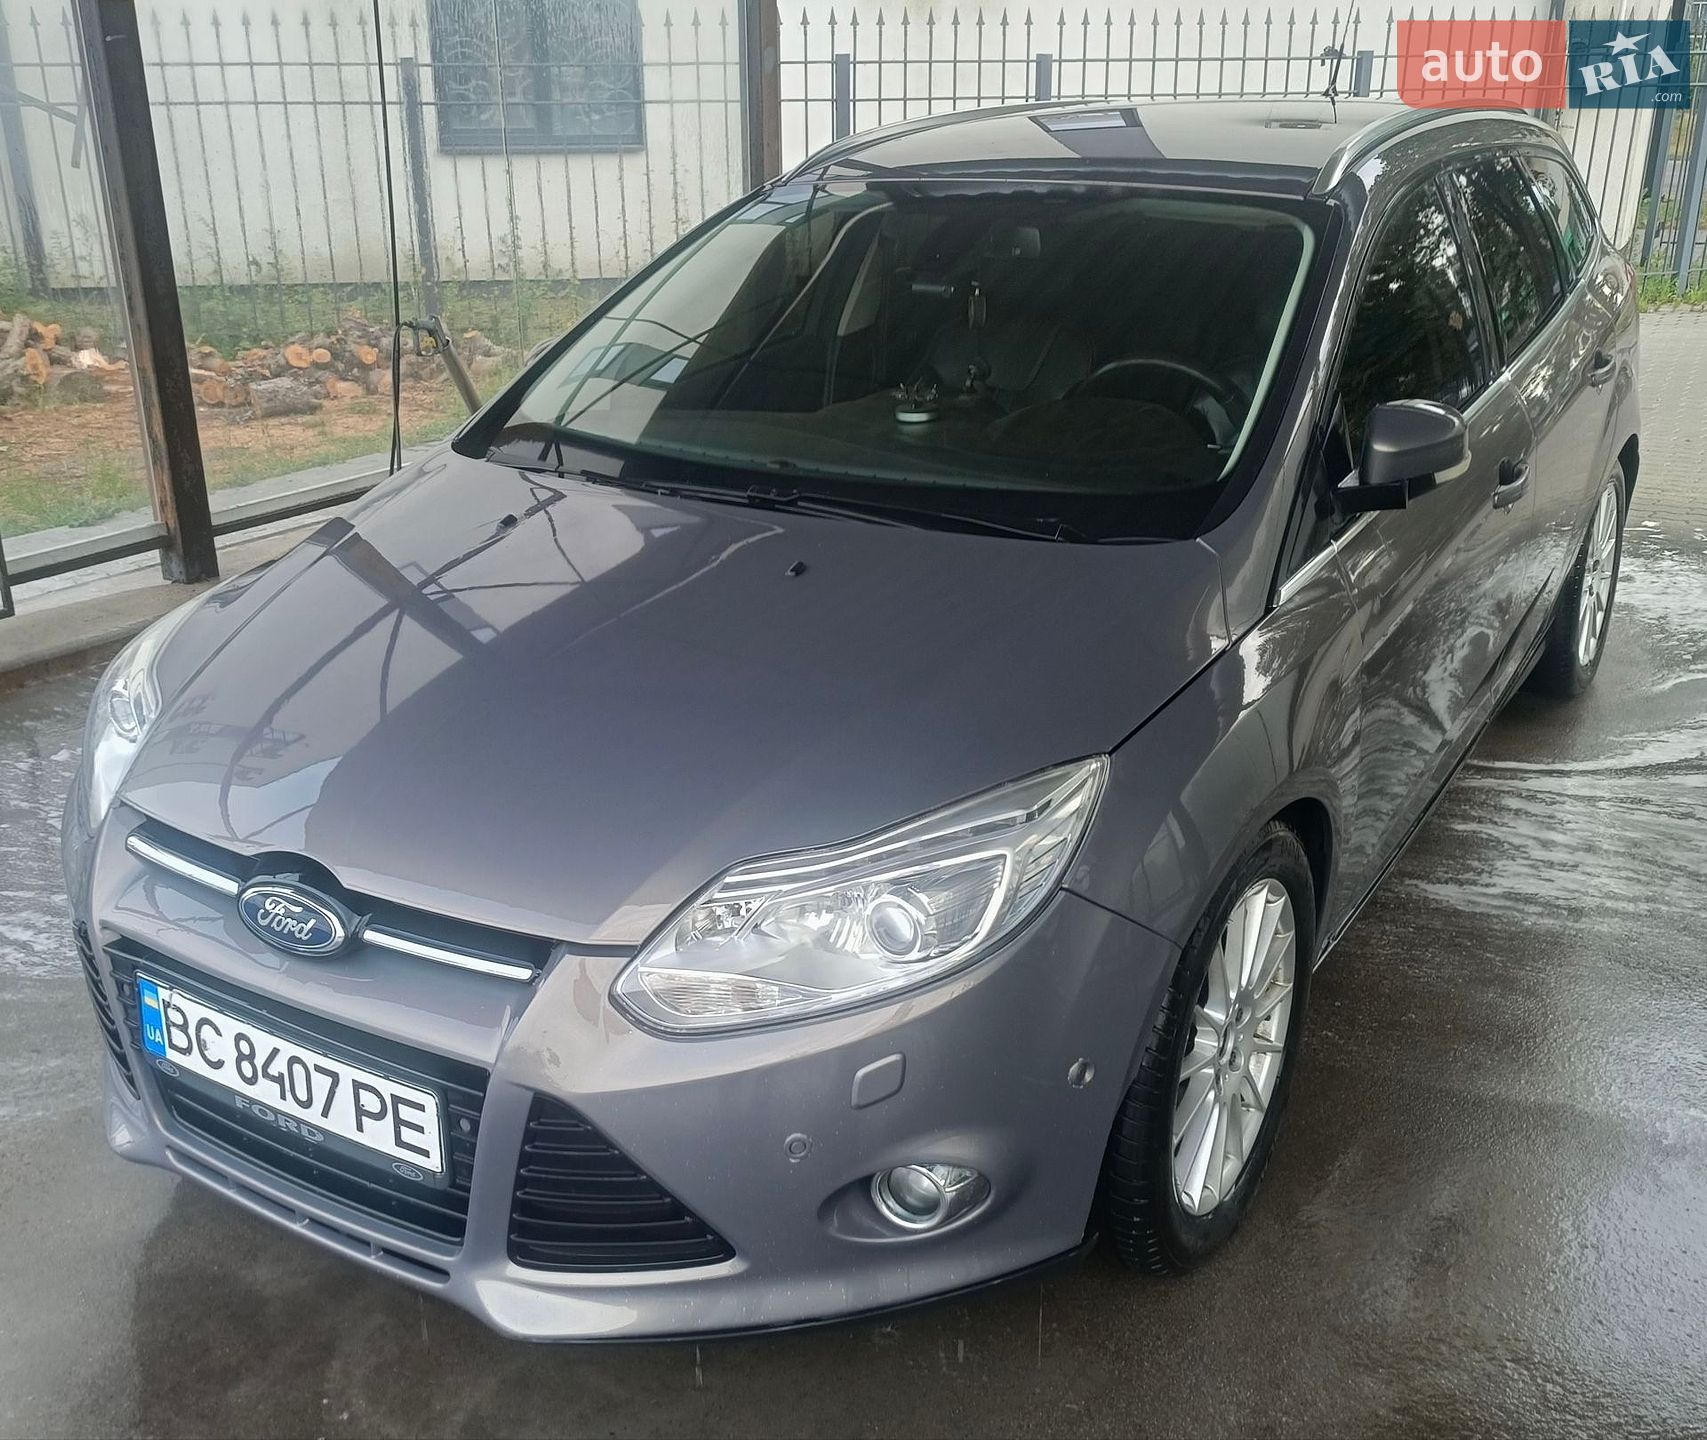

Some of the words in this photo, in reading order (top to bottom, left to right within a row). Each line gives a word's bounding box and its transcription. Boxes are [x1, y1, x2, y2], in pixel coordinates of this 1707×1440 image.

[257, 896, 316, 941] Ford
[146, 1023, 164, 1046] UA
[162, 998, 225, 1070] BC
[234, 1032, 340, 1119] 8407
[352, 1078, 431, 1159] PE
[234, 1094, 324, 1144] FORD
